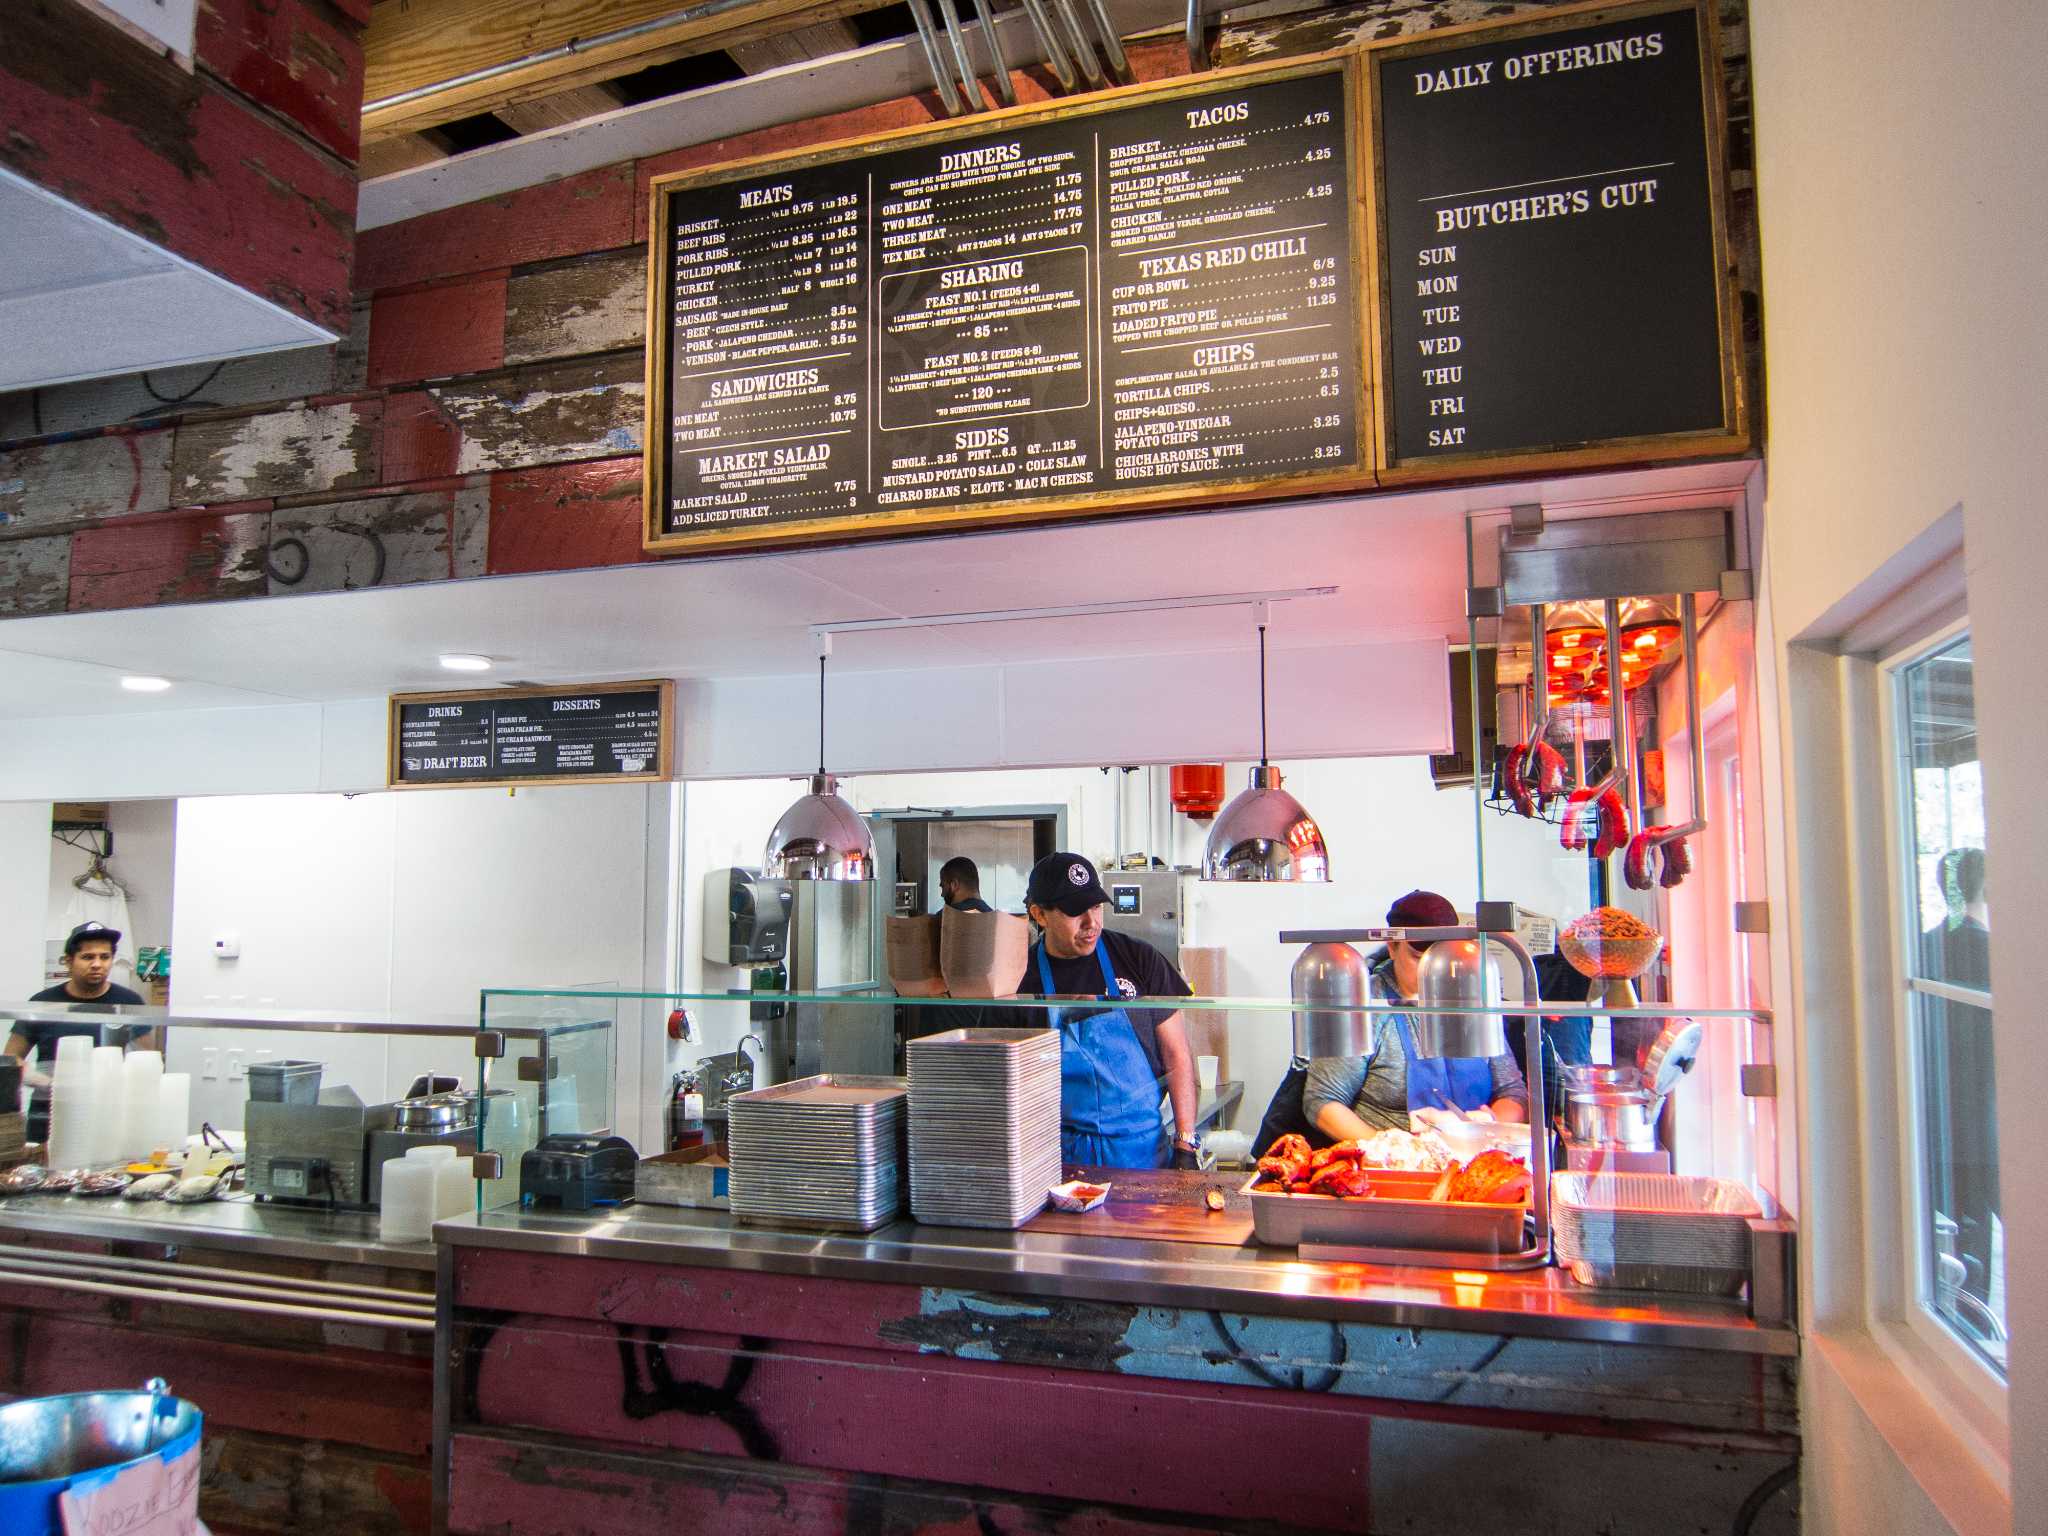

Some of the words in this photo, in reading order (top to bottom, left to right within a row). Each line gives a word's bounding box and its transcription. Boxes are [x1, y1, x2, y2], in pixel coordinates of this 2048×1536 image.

[1416, 62, 1492, 95] DAILY
[1505, 33, 1662, 79] OFFERINGS
[1186, 102, 1248, 128] TACOS
[1110, 140, 1160, 159] BRISKET
[1304, 111, 1329, 125] 4.75
[941, 143, 1020, 172] DINNERS
[1109, 156, 1143, 168] CHOPPED
[1179, 144, 1215, 156] CHEDDAR
[1109, 167, 1130, 177] SOUR
[1159, 158, 1184, 169] SALSA
[1185, 154, 1205, 165] ROJA
[890, 179, 919, 190] DINNERS
[920, 176, 934, 185] ARE
[935, 171, 961, 182] SERVED
[961, 168, 979, 177] WITH
[980, 164, 999, 174] YOUR
[1000, 160, 1025, 170] CHOICE
[1110, 177, 1154, 194] PULLED
[1156, 170, 1189, 186] PORK
[1305, 148, 1331, 161] 4.25
[740, 185, 792, 208] MEATS
[882, 203, 903, 216] ONE
[904, 198, 932, 212] MEAT
[1055, 172, 1082, 187] 11.75
[1111, 211, 1162, 229] CHICKEN
[1306, 184, 1332, 198] 4.25
[1435, 188, 1589, 232] BUTCHER'S
[1602, 180, 1656, 208] CUT
[678, 219, 719, 235] BRISKET
[792, 201, 814, 214] 9.75
[837, 194, 857, 207] 19.5
[882, 218, 905, 232] TWO
[906, 213, 934, 228] MEAT
[1053, 189, 1082, 203] 14.75
[677, 237, 701, 250] BEEF
[702, 233, 725, 246] RIBS
[844, 210, 857, 221] 22
[882, 232, 917, 248] THREE
[918, 227, 946, 242] MEAT
[1053, 206, 1082, 220] 17.75
[677, 252, 703, 265] PORK
[705, 247, 728, 260] RIBS
[792, 232, 813, 246] 8.25
[837, 225, 857, 238] 16.5
[882, 251, 902, 264] TEX
[903, 247, 925, 260] MEX
[1004, 232, 1016, 245] 14
[1070, 222, 1083, 234] 17
[1419, 246, 1456, 265] SUN
[676, 265, 713, 280] PULLED
[714, 260, 741, 274] PORK
[846, 241, 857, 252] 14
[1139, 252, 1201, 278] TEXAS
[1205, 246, 1246, 268] RED
[1250, 237, 1306, 261] CHILI
[676, 280, 714, 295] TURKEY
[846, 257, 857, 268] 16
[941, 261, 1023, 288] SHARING
[1112, 285, 1135, 299] CUP
[1137, 283, 1154, 295] OR
[1155, 278, 1189, 293] BOWL
[1417, 276, 1458, 296] MON
[676, 295, 718, 311] CHICKEN
[781, 284, 800, 294] HALF
[819, 277, 844, 288] WHOLE
[845, 273, 857, 284] 16
[925, 293, 960, 309] FEAST
[1112, 301, 1147, 316] FRITO
[1149, 298, 1168, 311] PIE
[1309, 275, 1335, 289] 9.25
[675, 311, 718, 326] SAUSAGE
[1112, 317, 1158, 333] LOADED
[1160, 312, 1196, 327] FRITO
[1197, 309, 1217, 322] PIE
[1306, 292, 1336, 307] 11.25
[1423, 306, 1459, 325] TUE
[686, 325, 710, 338] BEEF
[715, 323, 740, 334] CZECH
[740, 319, 764, 330] STYLE
[686, 339, 713, 352] PORK
[757, 329, 794, 342] CHEDDAR
[974, 324, 990, 338] 85
[1112, 332, 1141, 343] TOPPED
[1142, 329, 1162, 339] WITH
[1163, 324, 1198, 336] CHOPPED
[1200, 321, 1219, 331] BEEF
[1220, 320, 1233, 328] OR
[1234, 315, 1264, 326] PULLED
[1265, 312, 1288, 322] PORK
[686, 351, 726, 366] VENISON
[731, 348, 757, 360] BLACK
[788, 339, 818, 351] GARLIC
[1193, 342, 1254, 366] CHIPS
[1419, 337, 1461, 355] WED
[924, 354, 959, 369] FEAST
[1174, 369, 1198, 379] SALSA
[1423, 366, 1462, 385] THU
[711, 368, 818, 398] SANDWICHES
[972, 385, 993, 400] 120
[1113, 387, 1171, 404] TORTILLA
[1173, 381, 1210, 396] CHIPS
[1320, 366, 1338, 379] 2.5
[674, 414, 693, 426] ONE
[694, 411, 719, 424] MEAT
[834, 392, 856, 405] 8.75
[949, 401, 1003, 414] SUBSTITUTIONS
[1004, 397, 1030, 408] PLEASE
[1114, 401, 1195, 421] CHIPS+QUESO
[1320, 384, 1339, 397] 6.5
[1430, 397, 1464, 415] FRI
[673, 430, 694, 442] TWO
[695, 426, 721, 439] MEAT
[830, 409, 856, 422] 10.75
[955, 427, 1009, 449] SIDES
[1114, 435, 1160, 450] POTATO
[1161, 430, 1198, 445] CHIPS
[1313, 414, 1340, 428] 3.25
[1429, 428, 1465, 446] SAT
[699, 451, 768, 474] MARKET
[773, 444, 830, 465] SALAD
[1115, 447, 1208, 467] CHICHARRONES
[1212, 443, 1244, 457] WITH
[1115, 465, 1153, 480] HOUSE
[1155, 462, 1179, 475] HOT
[1181, 458, 1219, 472] SAUCE
[883, 471, 934, 487] MUSTARD
[935, 466, 976, 481] POTATO
[978, 462, 1015, 476] SALAD
[1025, 458, 1054, 471] COLE
[1056, 454, 1086, 468] SLAW
[673, 495, 713, 509] MARKET
[714, 492, 747, 505] SALAD
[834, 479, 856, 492] 7.75
[877, 489, 923, 504] CHARRO
[924, 485, 960, 499] BEANS
[970, 480, 1004, 494] ELOTE
[1014, 477, 1038, 490] MAC
[1051, 471, 1093, 486] CHEESE
[672, 514, 693, 525] ADD
[694, 510, 731, 523] SLICED
[729, 505, 769, 519] TURKEY
[429, 706, 462, 717] DRINKS
[553, 699, 600, 711] DESSERTS
[424, 758, 458, 769] DRAFT
[460, 756, 487, 768] BEER
